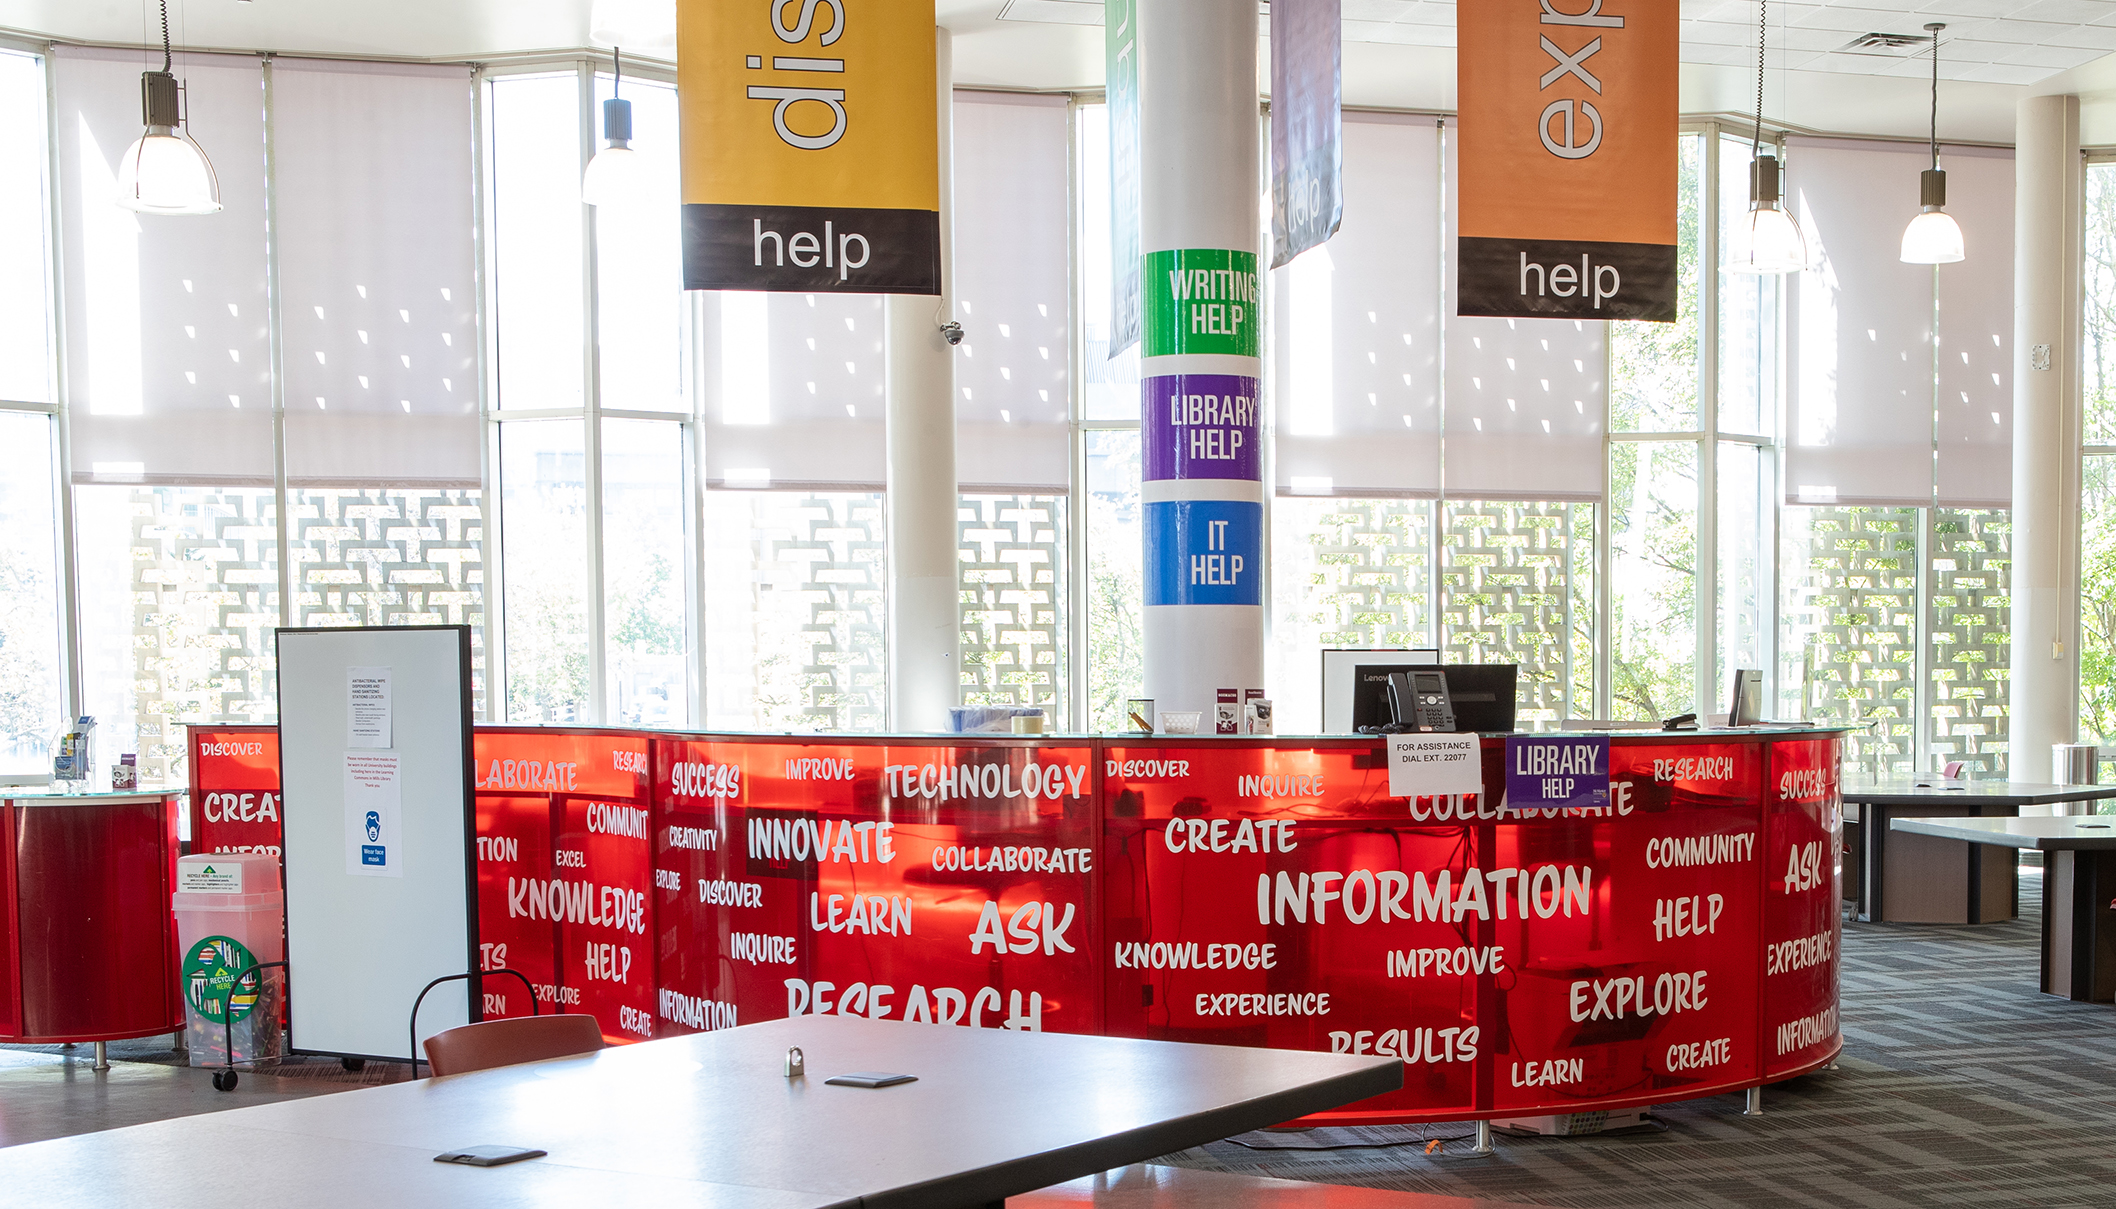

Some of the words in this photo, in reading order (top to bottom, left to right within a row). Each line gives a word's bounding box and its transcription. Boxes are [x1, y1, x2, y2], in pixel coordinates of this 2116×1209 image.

[746, 0, 847, 150] dis
[1287, 169, 1320, 233] help
[753, 218, 870, 280] help
[1169, 269, 1256, 304] WRITING
[1520, 251, 1620, 309] help
[1191, 303, 1243, 335] HELP
[1171, 394, 1256, 428] LIBRARY
[1190, 428, 1243, 459] HELP
[1208, 520, 1227, 551] IT
[1191, 553, 1243, 585] HELP
[201, 742, 262, 756] DISCOVER
[1397, 743, 1414, 751] FOR
[1416, 741, 1471, 751] ASSISTANCE
[1402, 755, 1422, 763] DIAL
[1423, 754, 1442, 762] EXT.
[1444, 753, 1467, 762] 22077
[1516, 745, 1600, 776] LIBRARY
[671, 762, 740, 798] SUCCESS
[785, 757, 856, 781] IMPROVE
[884, 763, 1086, 800] TECHNOLOGY
[1106, 760, 1189, 777] DISCOVER
[1654, 757, 1732, 781] RESEARCH
[1780, 767, 1827, 800] SUCCESS
[1238, 774, 1325, 799] INQUIRE
[1542, 778, 1575, 799] HELP
[204, 792, 280, 823] CREA
[477, 836, 518, 862] TION
[669, 825, 718, 851] CREATIVITY
[748, 817, 897, 864] INNOVATE
[1165, 818, 1297, 853] CREATE
[1647, 833, 1754, 868] COMMUNITY
[555, 849, 587, 868] EXCEL
[932, 846, 1092, 873] COLLABORATE
[1785, 841, 1821, 894] ASK
[656, 868, 682, 891] EXPLORE
[698, 879, 763, 908] DISCOVER
[1258, 865, 1591, 925] INFORMATION
[508, 876, 646, 935] KNOWLEDGE
[811, 891, 912, 937] LEARN
[1653, 894, 1723, 941] HELP
[969, 899, 1076, 956] ASK
[584, 940, 631, 985] HELP
[731, 932, 797, 966] INQUIRE
[1115, 942, 1276, 969] KNOWLEDGE
[1388, 946, 1504, 977] IMPROVE
[1768, 931, 1831, 975] EXPERIENCE
[209, 975, 236, 985] RECYCLE
[1571, 971, 1707, 1022] EXPLORE
[620, 1004, 652, 1037] CREATE
[660, 988, 737, 1031] INFORMATION
[1196, 993, 1330, 1015] EXPERIENCE
[1328, 1025, 1480, 1064] RESULTS
[1667, 1038, 1730, 1071] CREATE
[1512, 1059, 1583, 1087] LEARN
